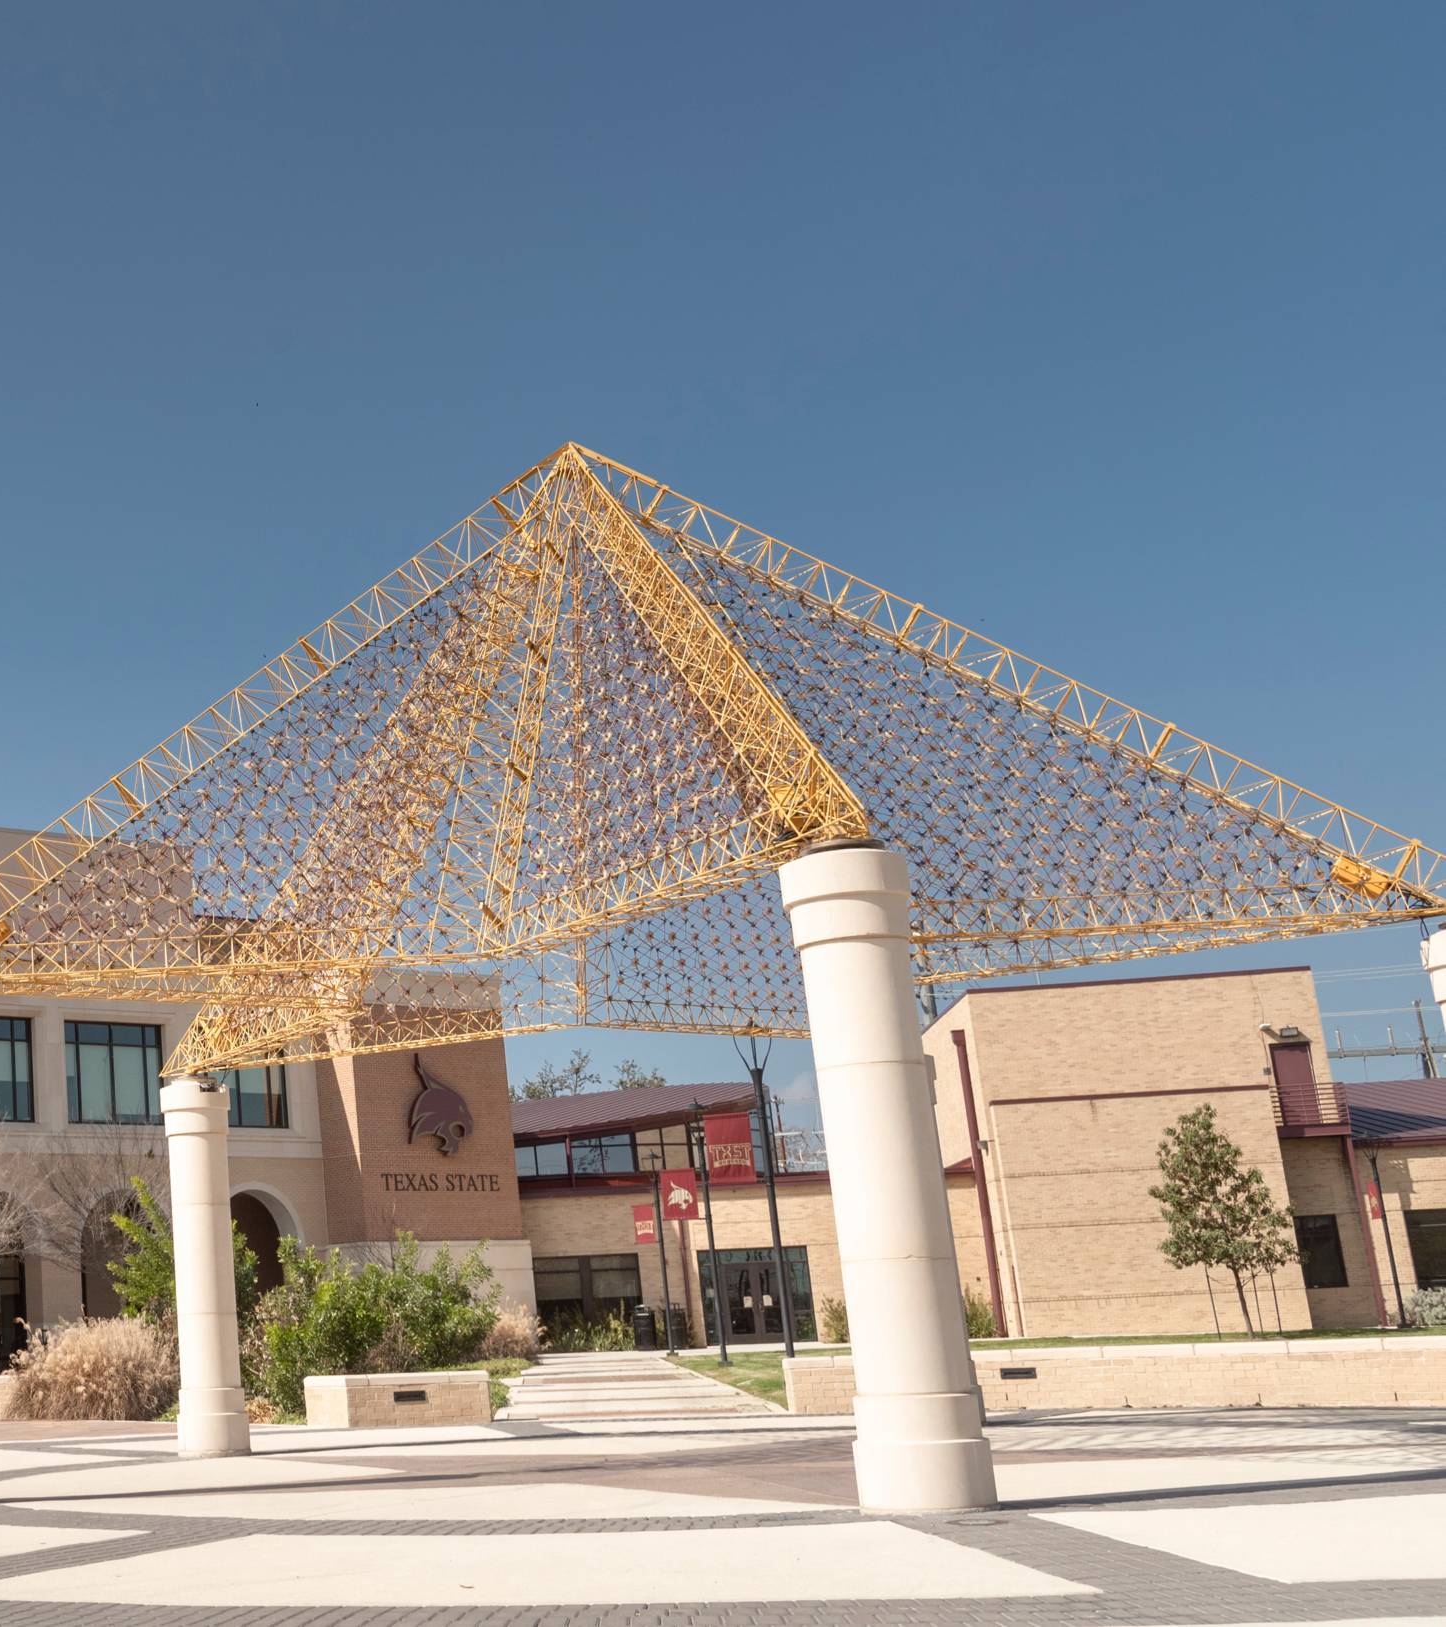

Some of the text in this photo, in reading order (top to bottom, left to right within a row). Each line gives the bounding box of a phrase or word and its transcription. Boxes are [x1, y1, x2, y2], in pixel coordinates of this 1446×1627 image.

[708, 1143, 752, 1161] TXST
[382, 1174, 500, 1192] TEXAS STATE
